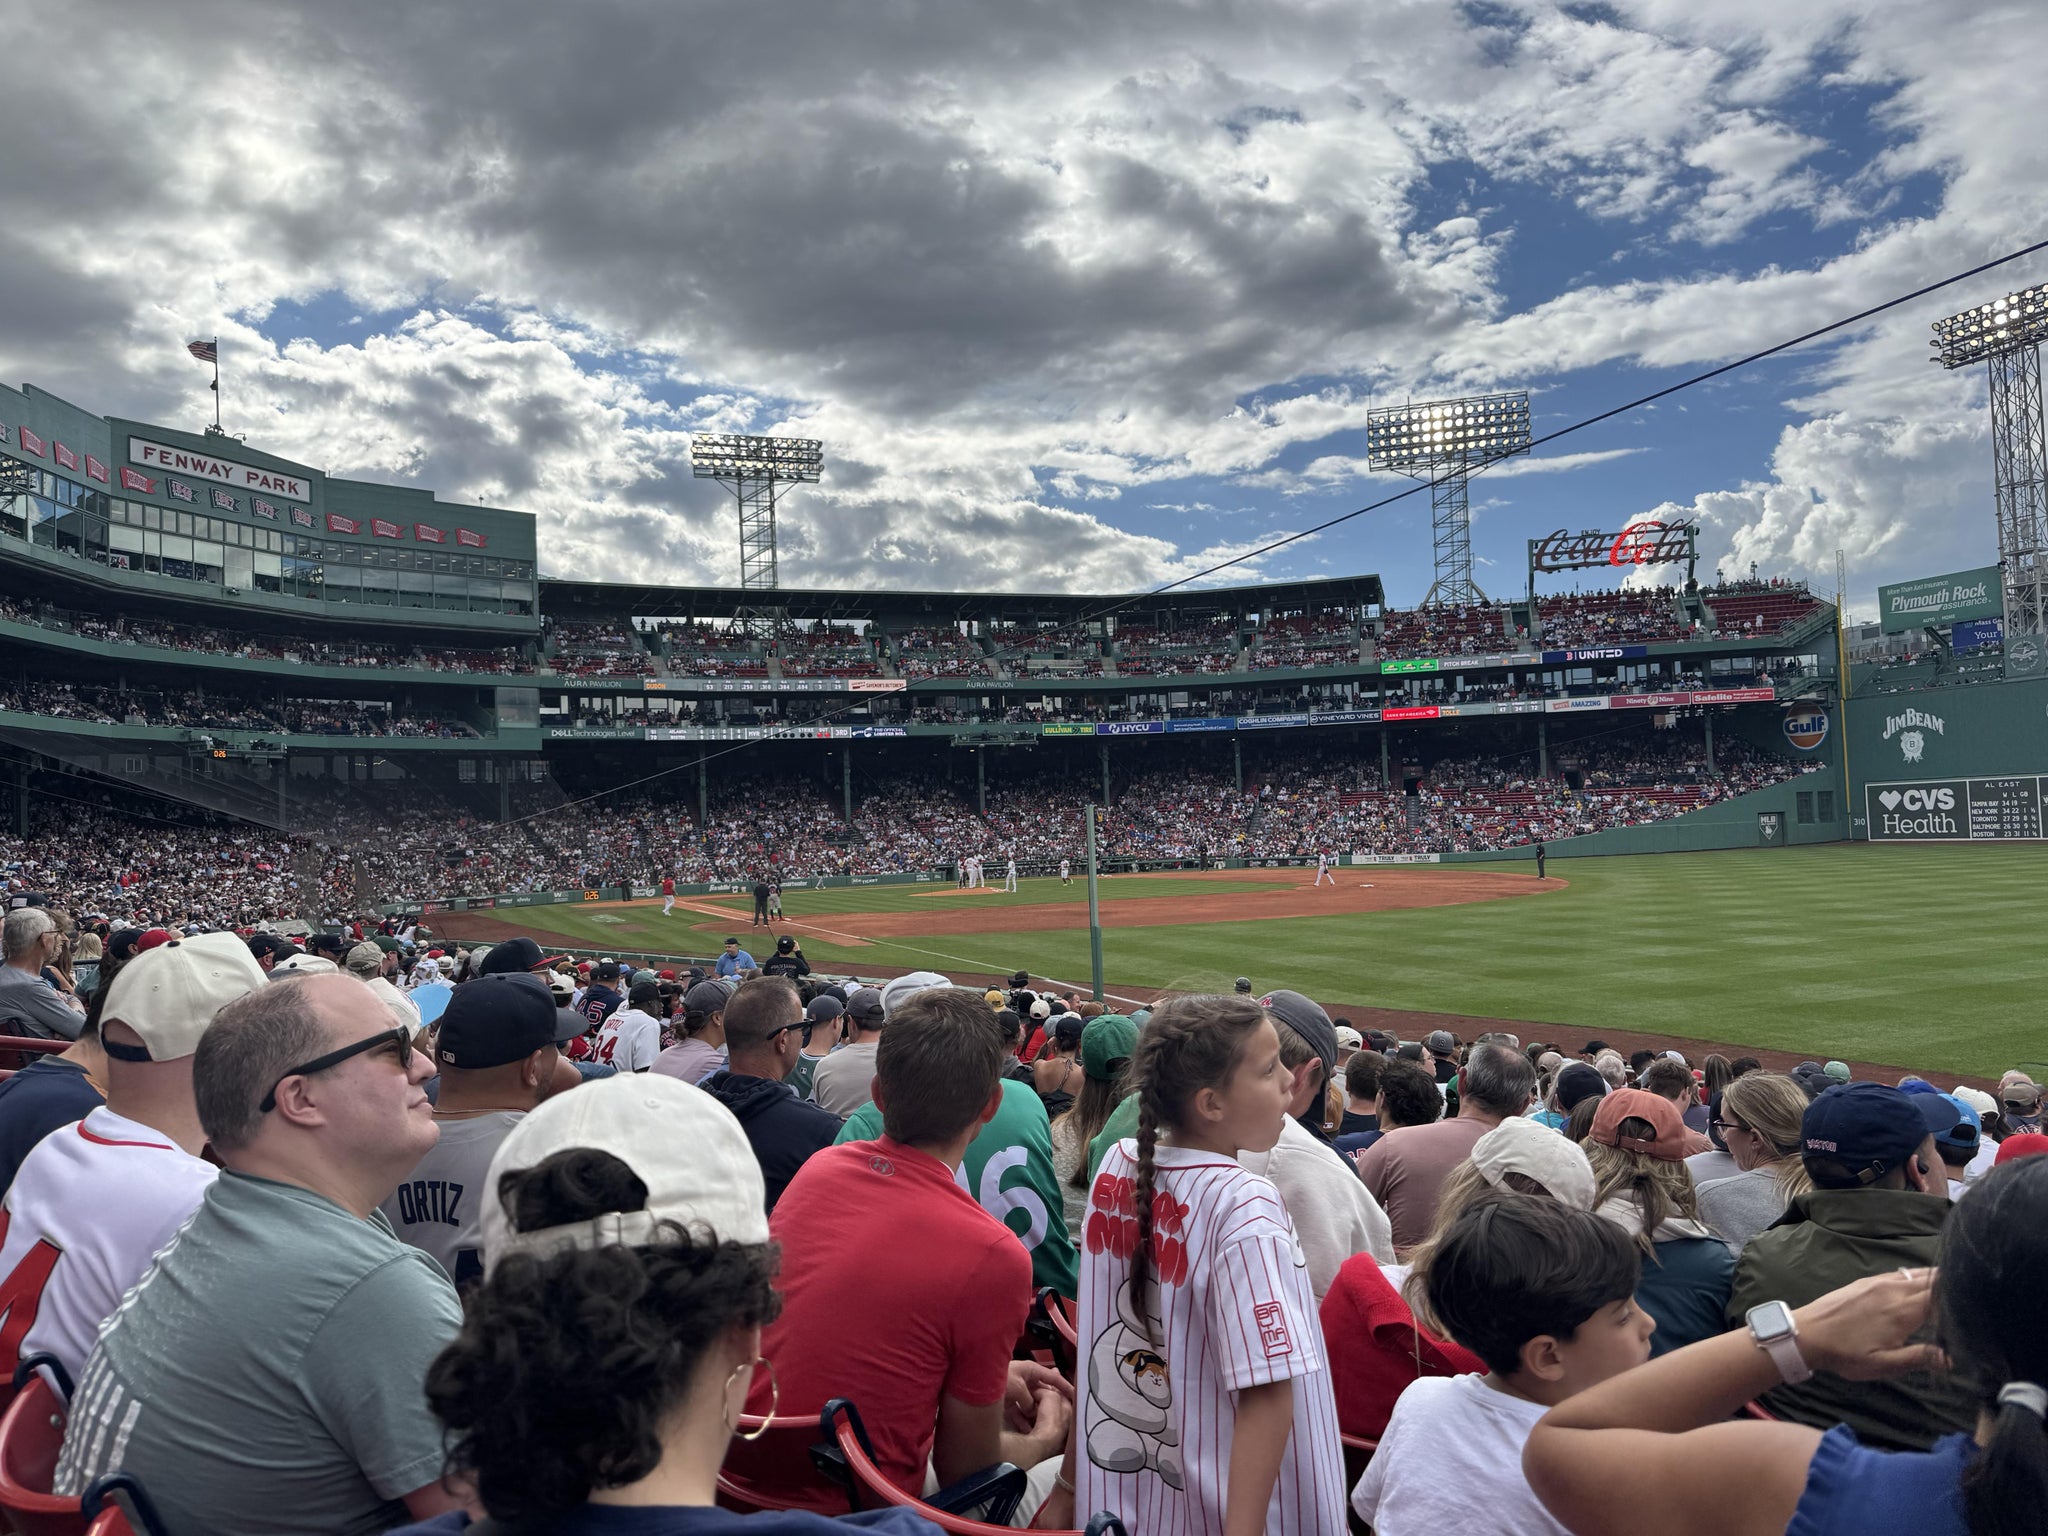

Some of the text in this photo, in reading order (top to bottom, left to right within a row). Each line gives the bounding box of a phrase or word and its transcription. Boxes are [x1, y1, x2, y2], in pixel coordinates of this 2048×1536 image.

[143, 446, 300, 496] FENWAY PARK
[1891, 582, 1986, 611] Plymouth Rock
[1974, 631, 1998, 640] Your
[1579, 649, 1623, 659] UNITED
[1571, 700, 1601, 708] AMAZING
[1626, 697, 1647, 705] Ninety
[1268, 713, 1307, 722] COMPANIES
[1356, 712, 1379, 720] VINES
[1121, 723, 1150, 732] HYCU
[1784, 716, 1826, 734] Gulf
[573, 730, 616, 739] Technologies
[1045, 726, 1072, 734] SULLIVAN
[1903, 788, 1955, 811] CVS
[1761, 816, 1776, 824] MLB
[1854, 818, 1866, 826] 310
[1883, 813, 1957, 834] Health
[397, 1180, 464, 1227] ORTIZ
